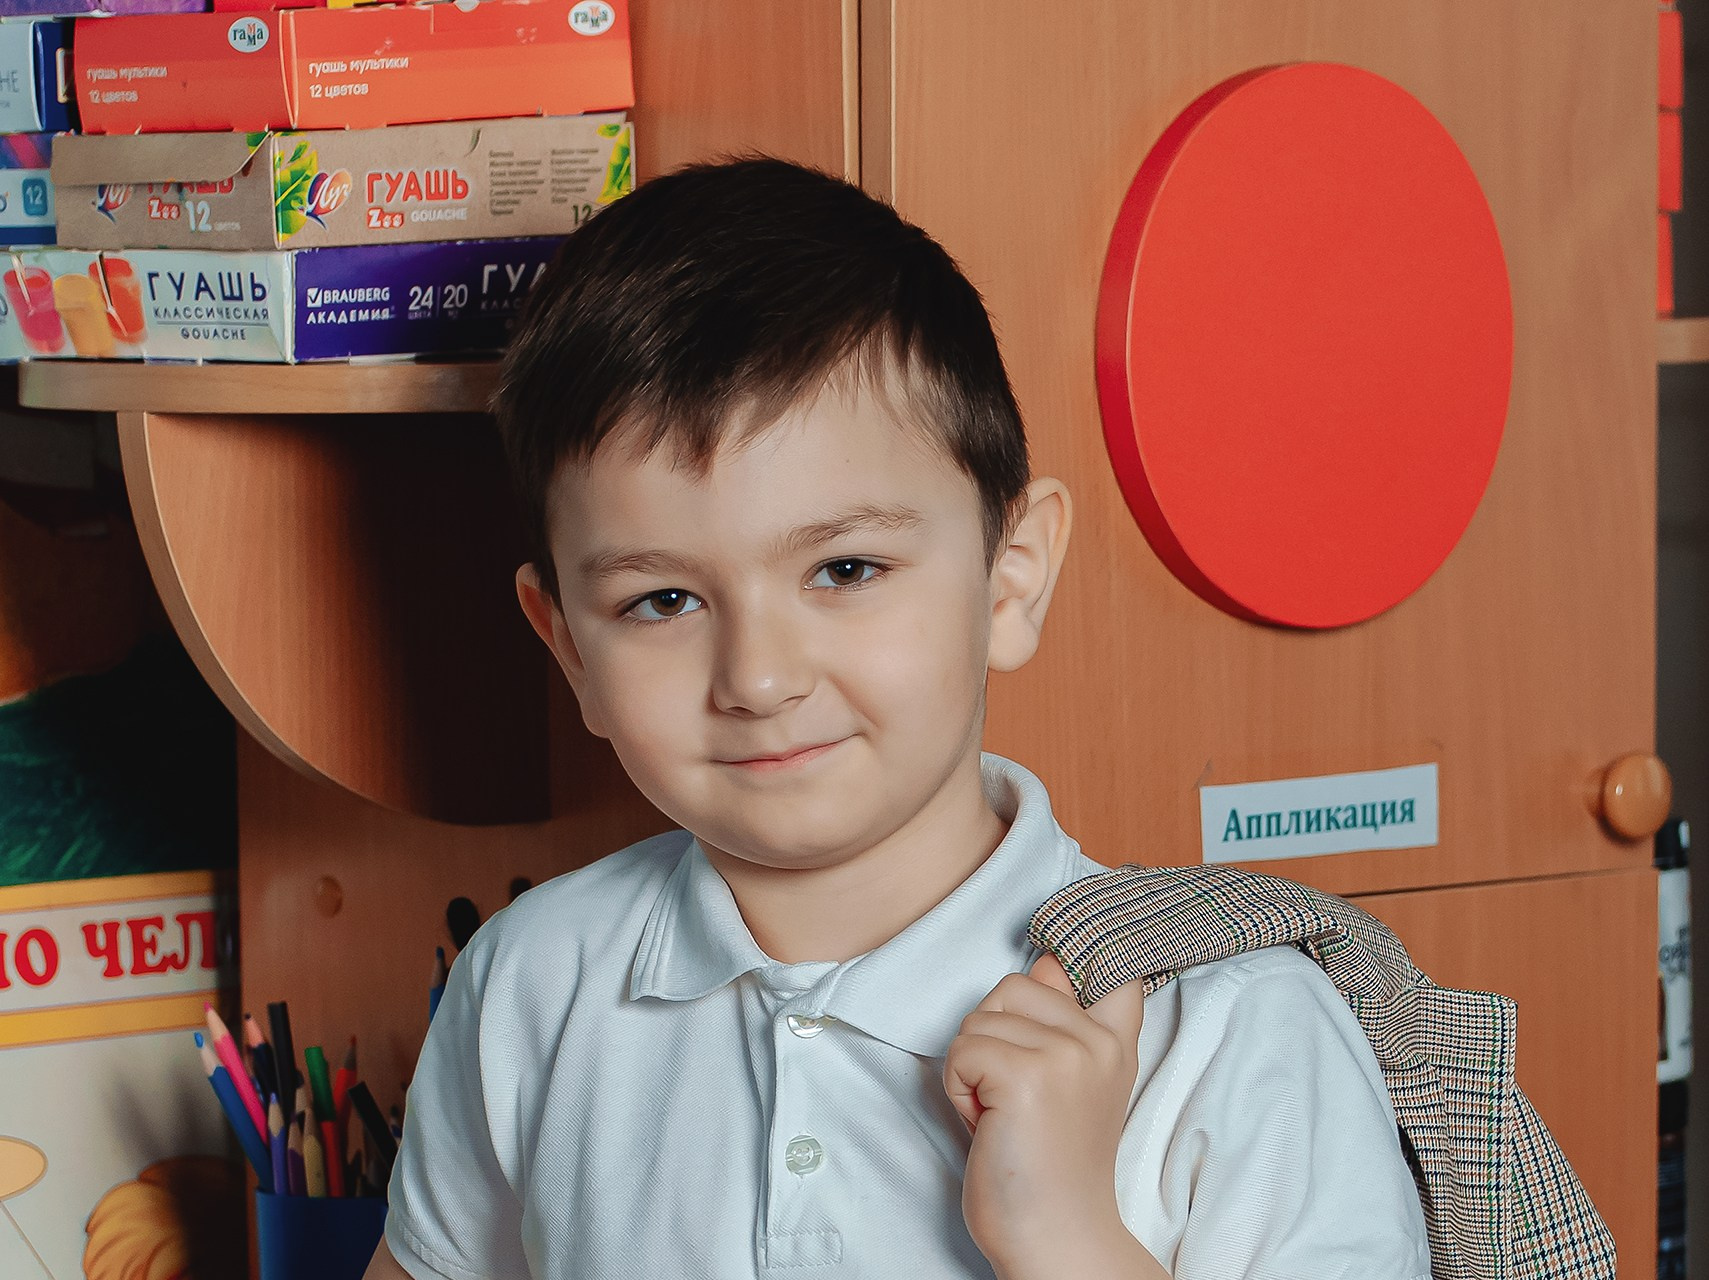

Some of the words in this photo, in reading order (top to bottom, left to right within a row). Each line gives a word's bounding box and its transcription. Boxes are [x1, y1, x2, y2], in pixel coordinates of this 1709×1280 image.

[308, 61, 348, 78] гуашь
[349, 57, 410, 75] мультики
[89, 89, 101, 104] 12
[309, 84, 323, 98] 12
[324, 83, 369, 98] цветов
[25, 185, 43, 206] 12
[367, 169, 470, 203] ГУАШЬ
[185, 200, 212, 232] 12
[410, 207, 469, 224] GOUACHE
[147, 271, 267, 302] ГУАШЬ
[323, 287, 390, 305] BRAUBERG
[443, 283, 469, 309] 20
[408, 285, 434, 311] 24
[153, 306, 269, 320] КЛАССИЧЕСКАЯ
[306, 308, 392, 325] АКАДЕМИЯ
[180, 327, 247, 341] GOUACHE
[1222, 797, 1417, 843] Аппликация
